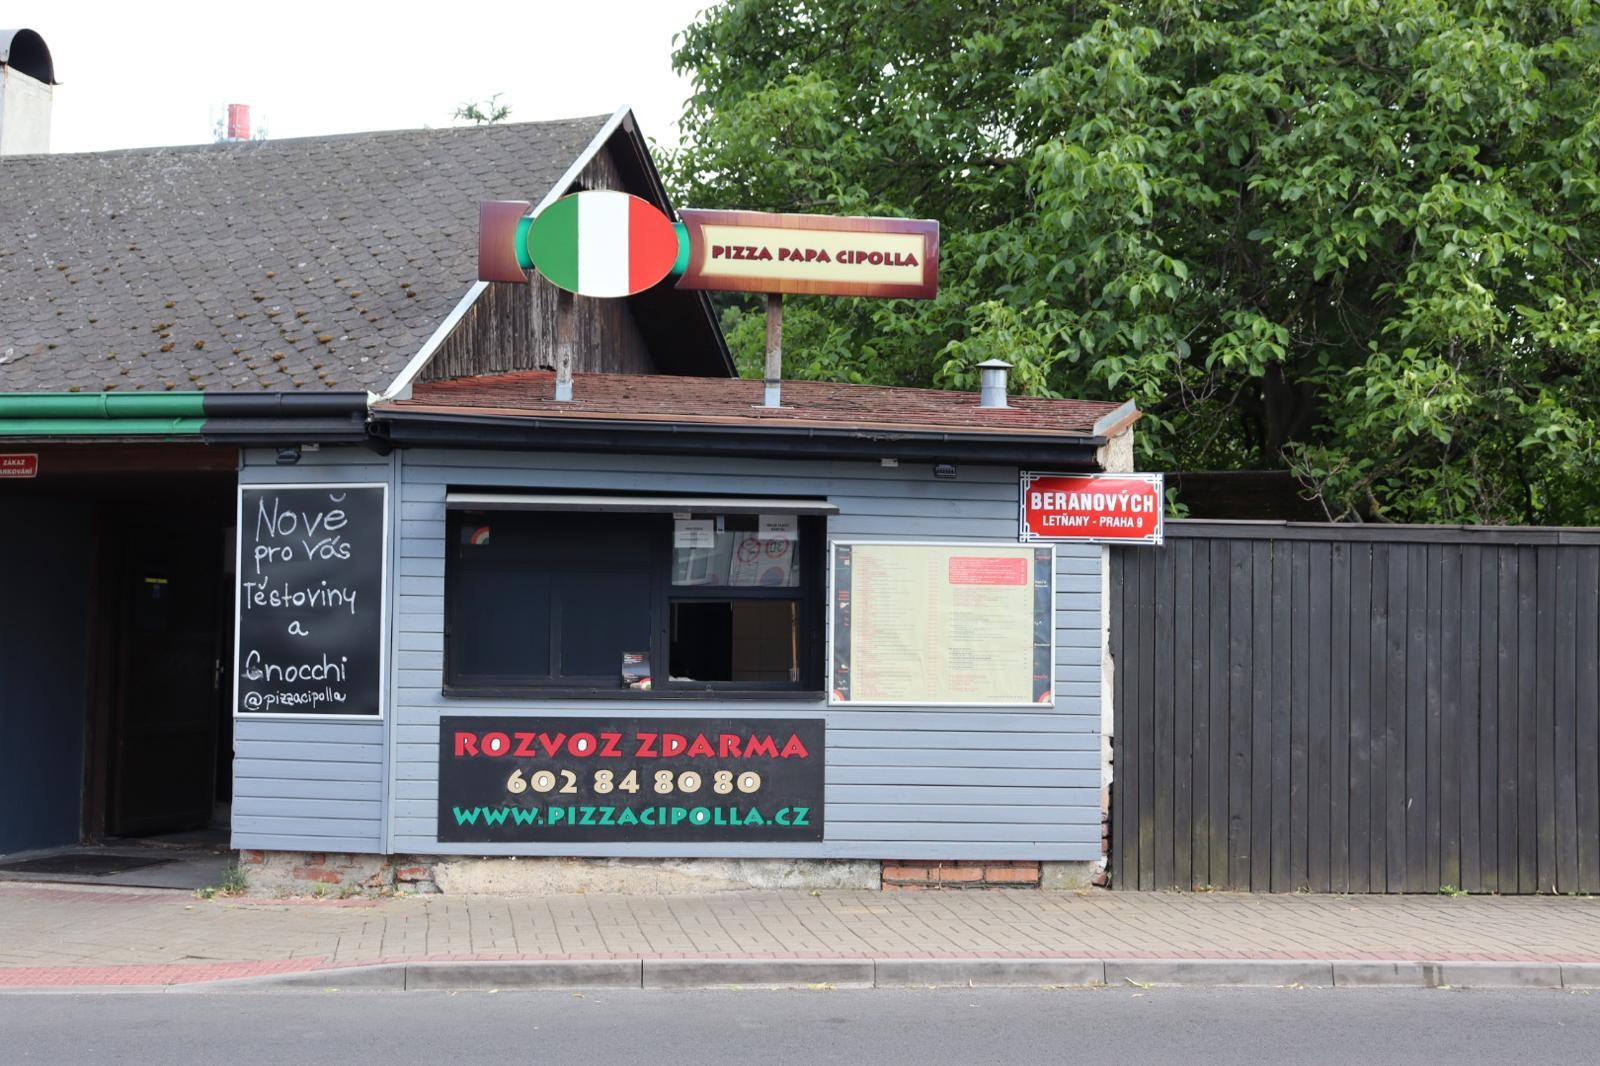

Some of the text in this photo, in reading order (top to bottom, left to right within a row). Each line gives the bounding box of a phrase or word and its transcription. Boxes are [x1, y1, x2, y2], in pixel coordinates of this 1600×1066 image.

[712, 245, 919, 267] PIZZA PAPA CIPOLLA
[1031, 490, 1153, 513] BERANOVÝCH
[256, 492, 348, 542] Nově
[1042, 512, 1090, 527] LETŇANY
[1099, 516, 1134, 528] PRAHA
[1136, 517, 1143, 528] 9
[254, 545, 293, 574] pro
[243, 576, 356, 614] Těstoviny
[288, 620, 309, 636] a
[454, 732, 809, 759] ROZVOZ ZDARMA
[507, 768, 761, 795] 602 84 80 80
[452, 806, 810, 826] WWW.PIZZACIPOLLA.CZ
